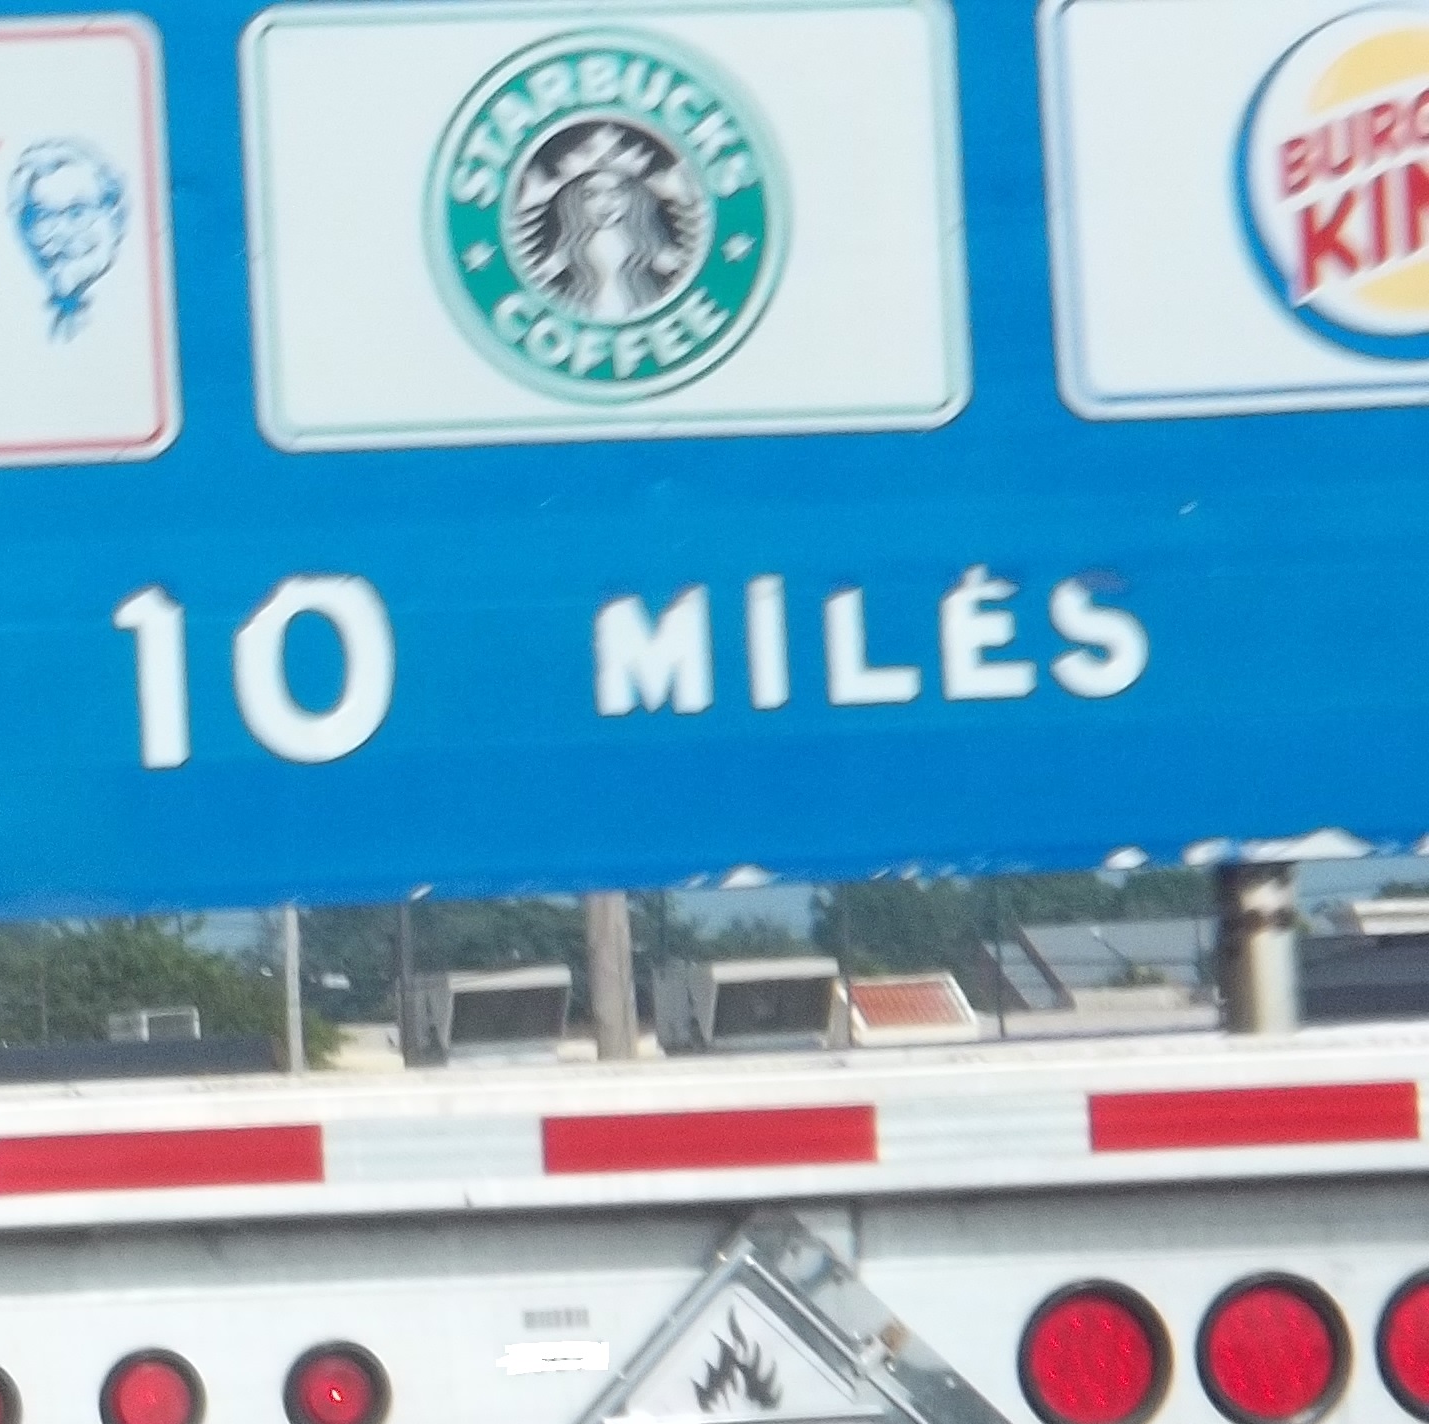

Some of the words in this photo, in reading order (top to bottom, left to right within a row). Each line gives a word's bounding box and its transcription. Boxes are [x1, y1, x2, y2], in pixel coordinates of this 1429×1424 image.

[450, 52, 762, 211] STARBUCKS
[491, 287, 731, 380] COFFEE
[113, 573, 396, 769] 10
[594, 563, 1150, 717] MILES
